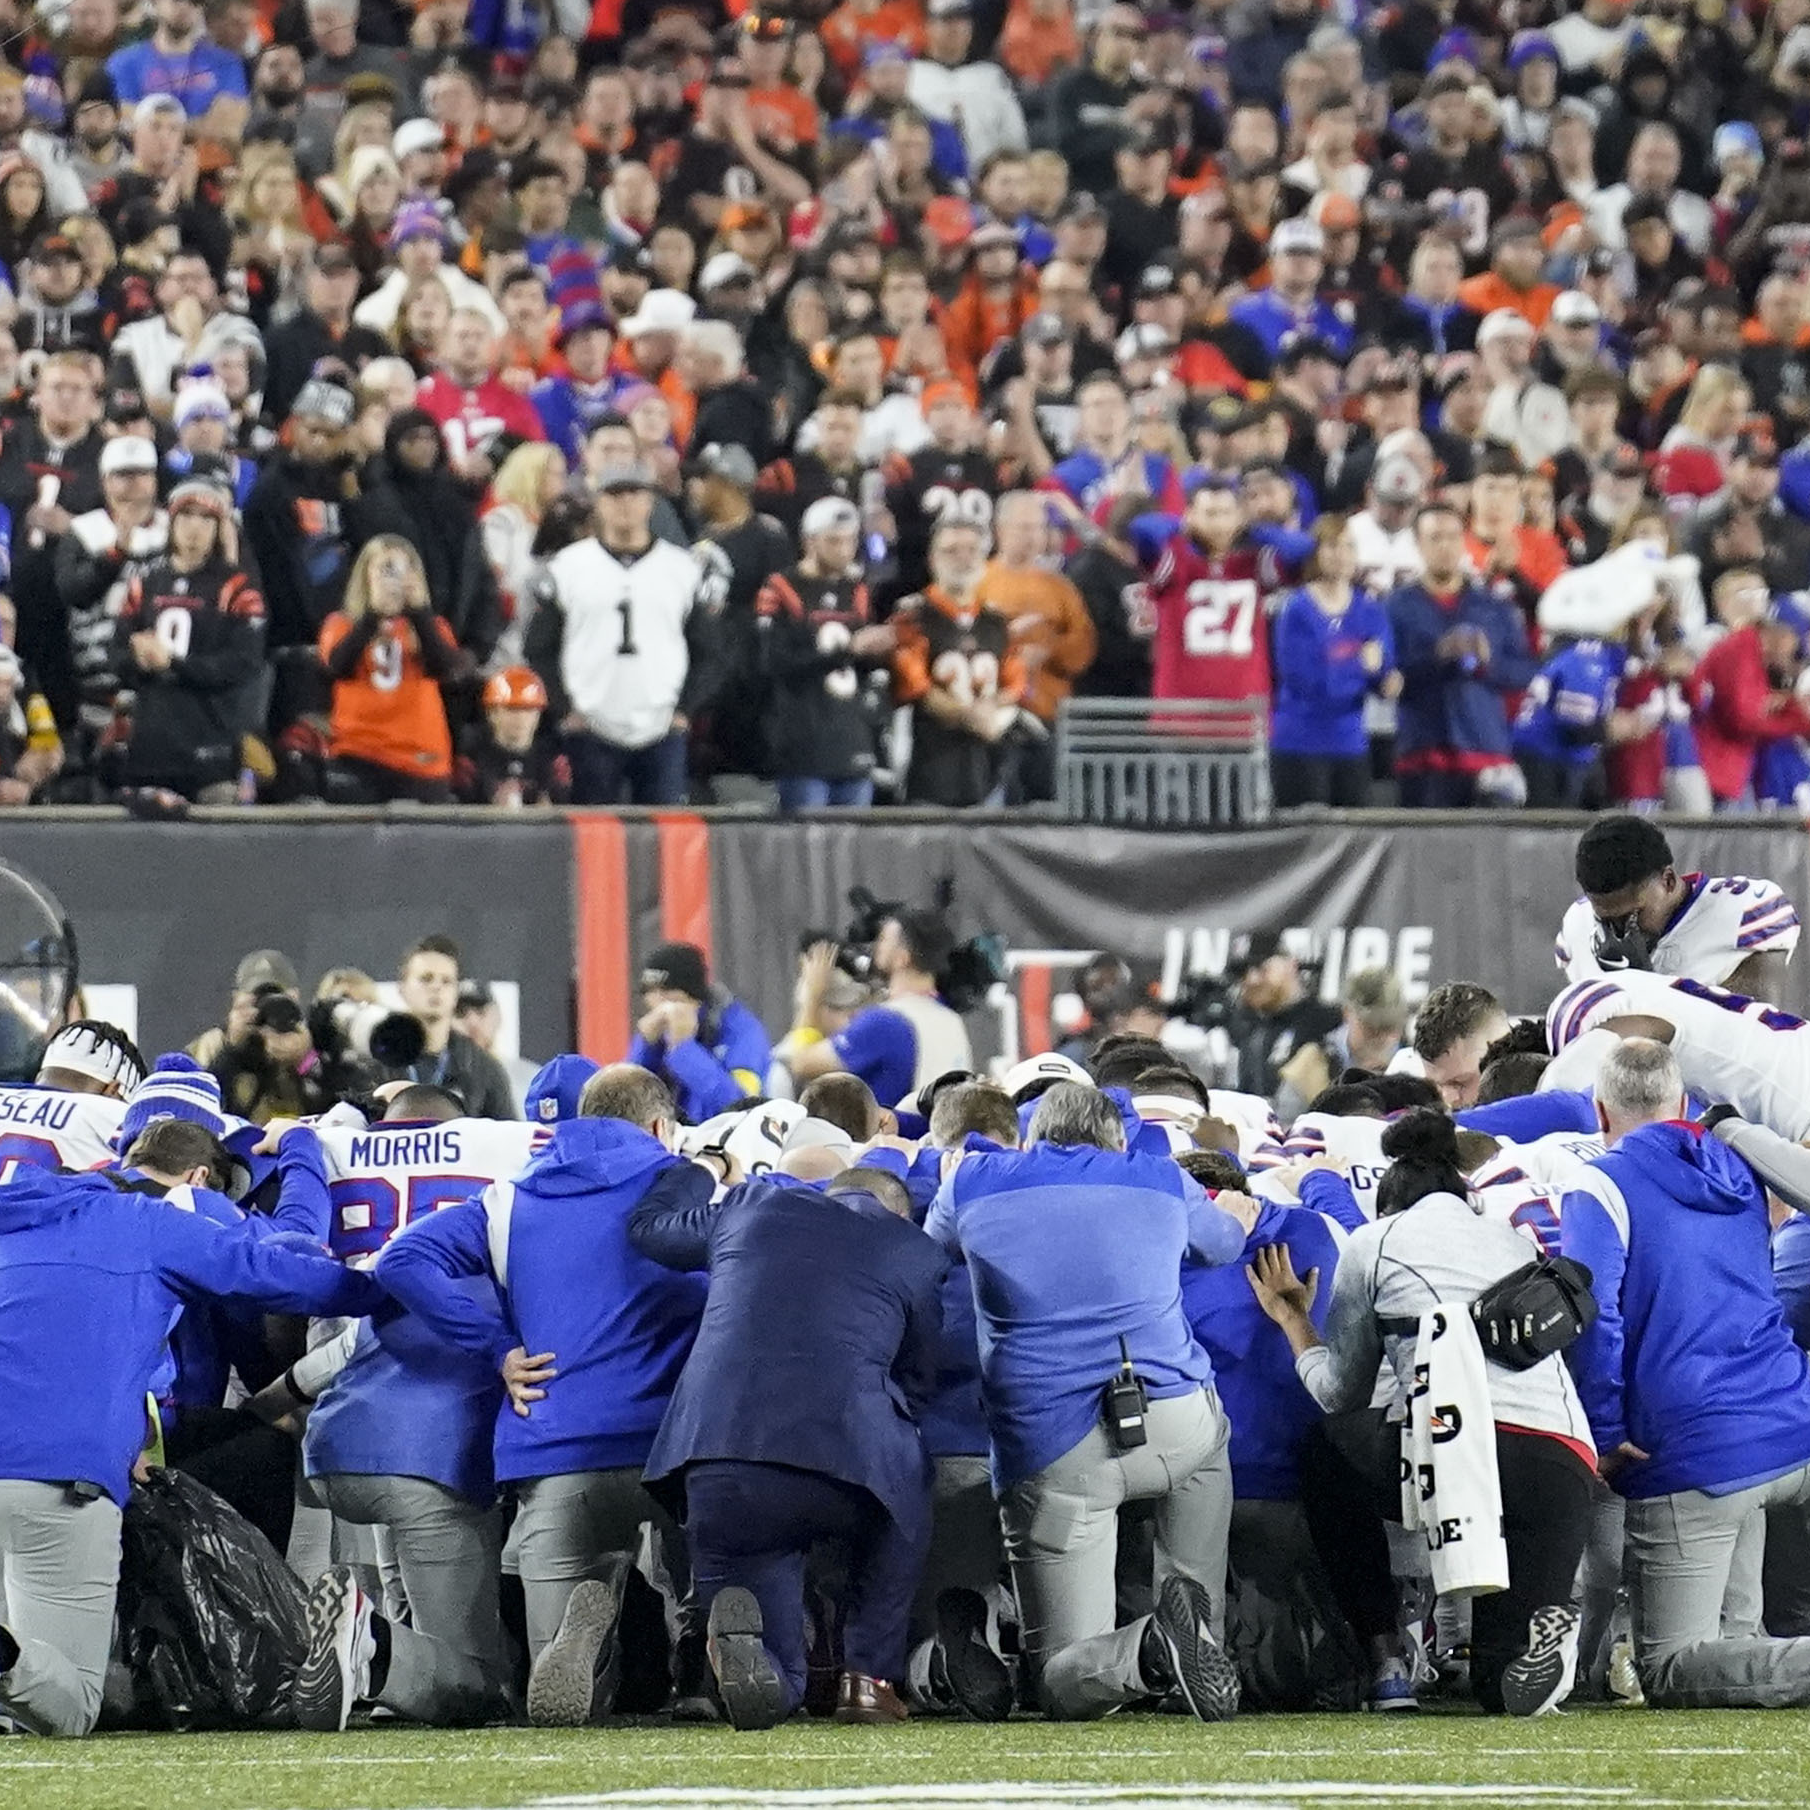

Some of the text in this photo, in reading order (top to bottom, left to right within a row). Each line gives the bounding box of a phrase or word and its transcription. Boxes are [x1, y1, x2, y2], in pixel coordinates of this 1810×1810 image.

[615, 599, 638, 656] 1
[1182, 578, 1260, 657] 27
[370, 641, 404, 691] 9
[350, 1131, 461, 1168] MORRIS
